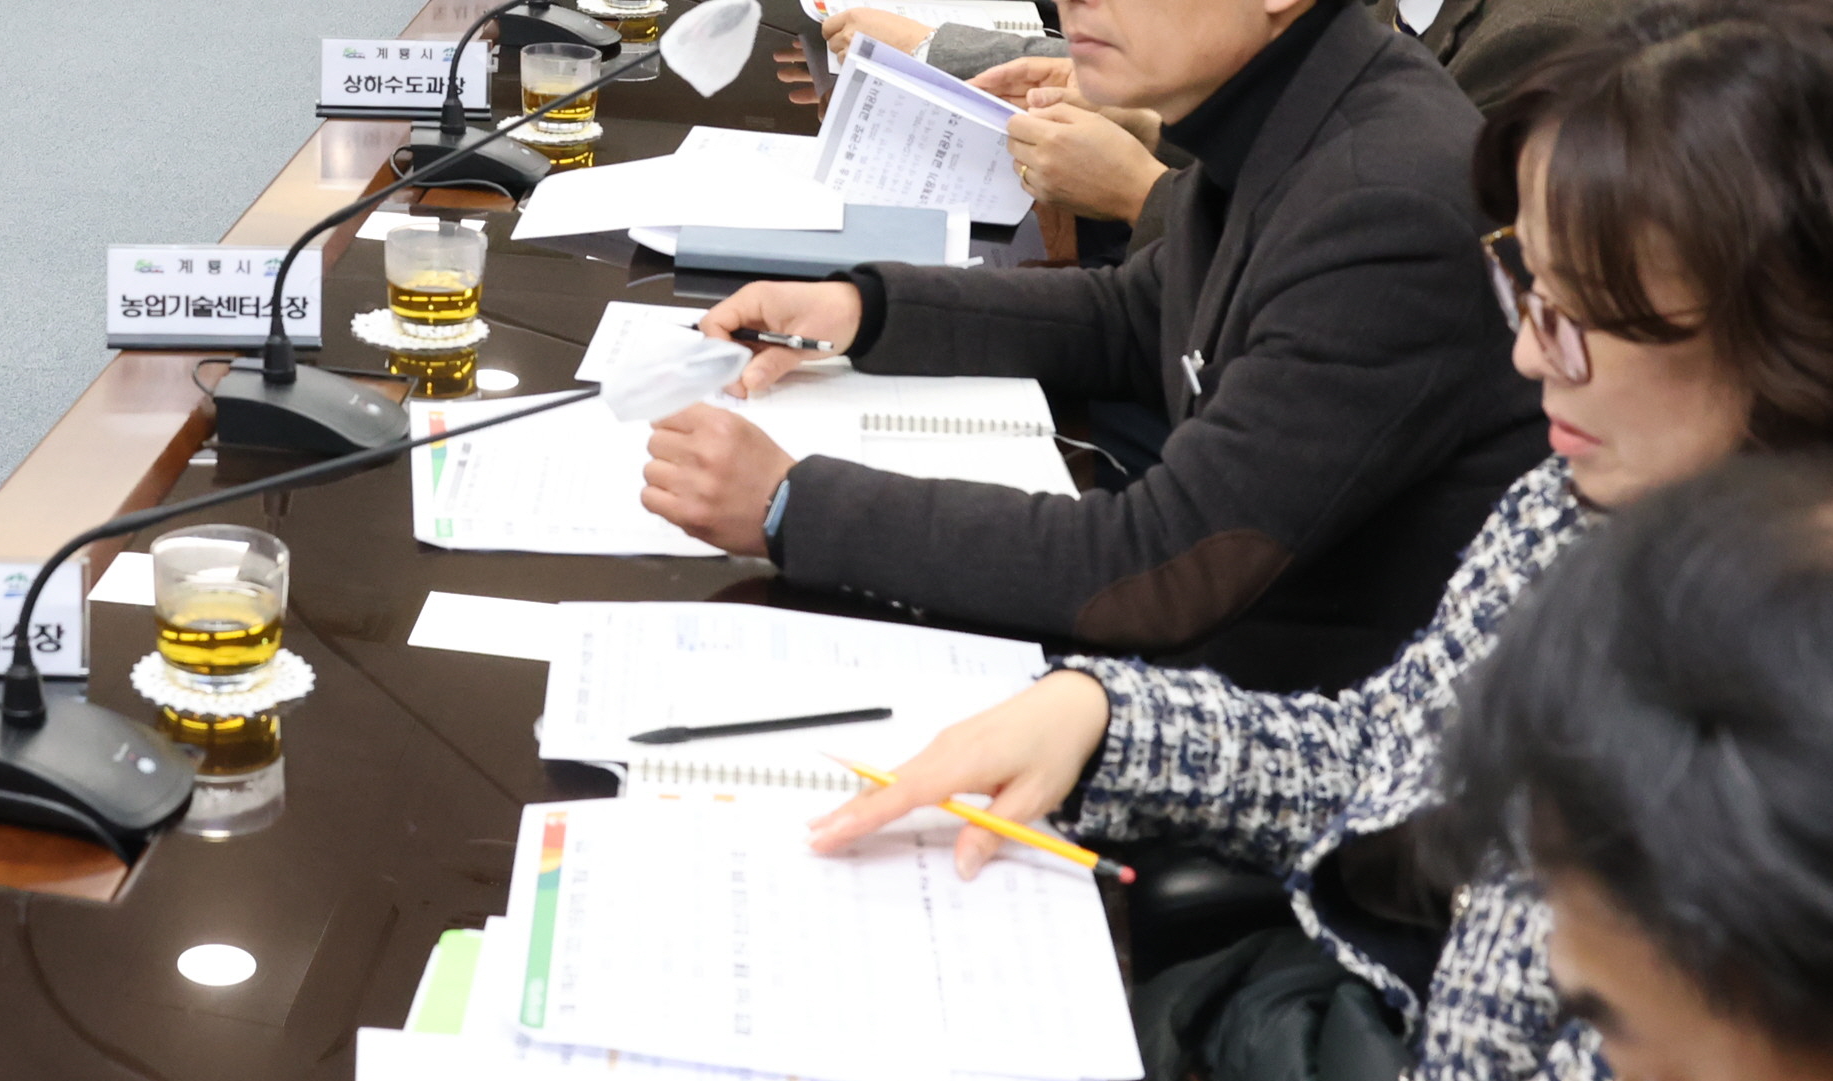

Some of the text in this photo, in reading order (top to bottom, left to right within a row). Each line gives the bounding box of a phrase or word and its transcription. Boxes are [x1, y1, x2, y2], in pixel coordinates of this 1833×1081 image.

[376, 47, 433, 60] 계룡시
[177, 258, 251, 275] 계룡시
[120, 294, 309, 320] 농업기술센터소장
